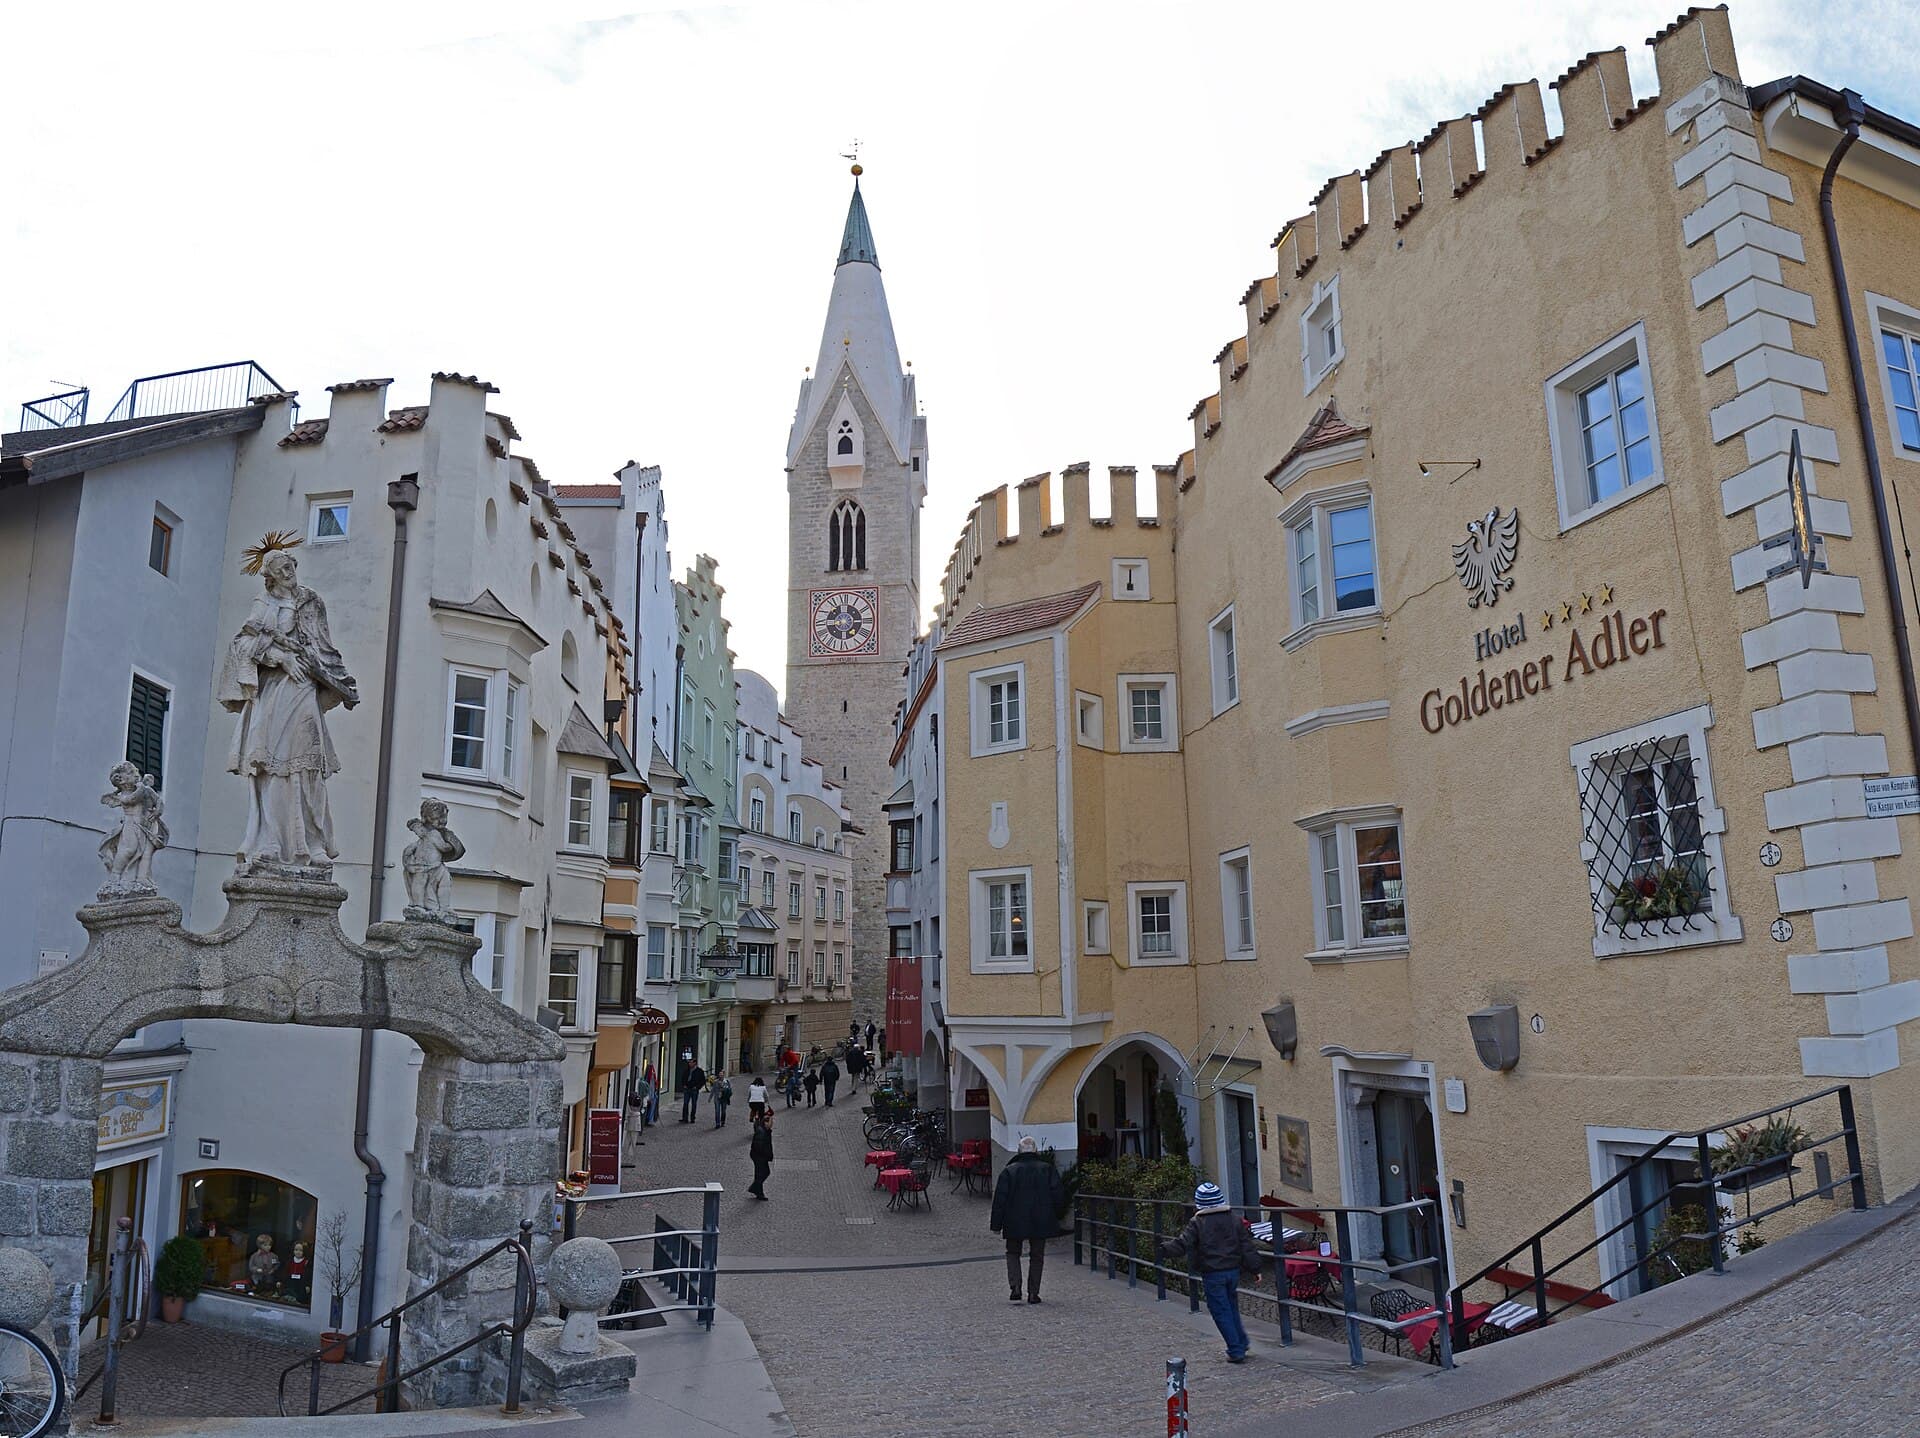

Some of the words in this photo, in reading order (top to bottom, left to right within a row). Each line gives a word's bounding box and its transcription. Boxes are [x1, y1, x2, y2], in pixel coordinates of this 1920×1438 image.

[1474, 612, 1527, 661] Hotel
[1420, 654, 1553, 734] Goldener
[1563, 608, 1666, 681] Adler
[639, 1015, 666, 1025] awa
